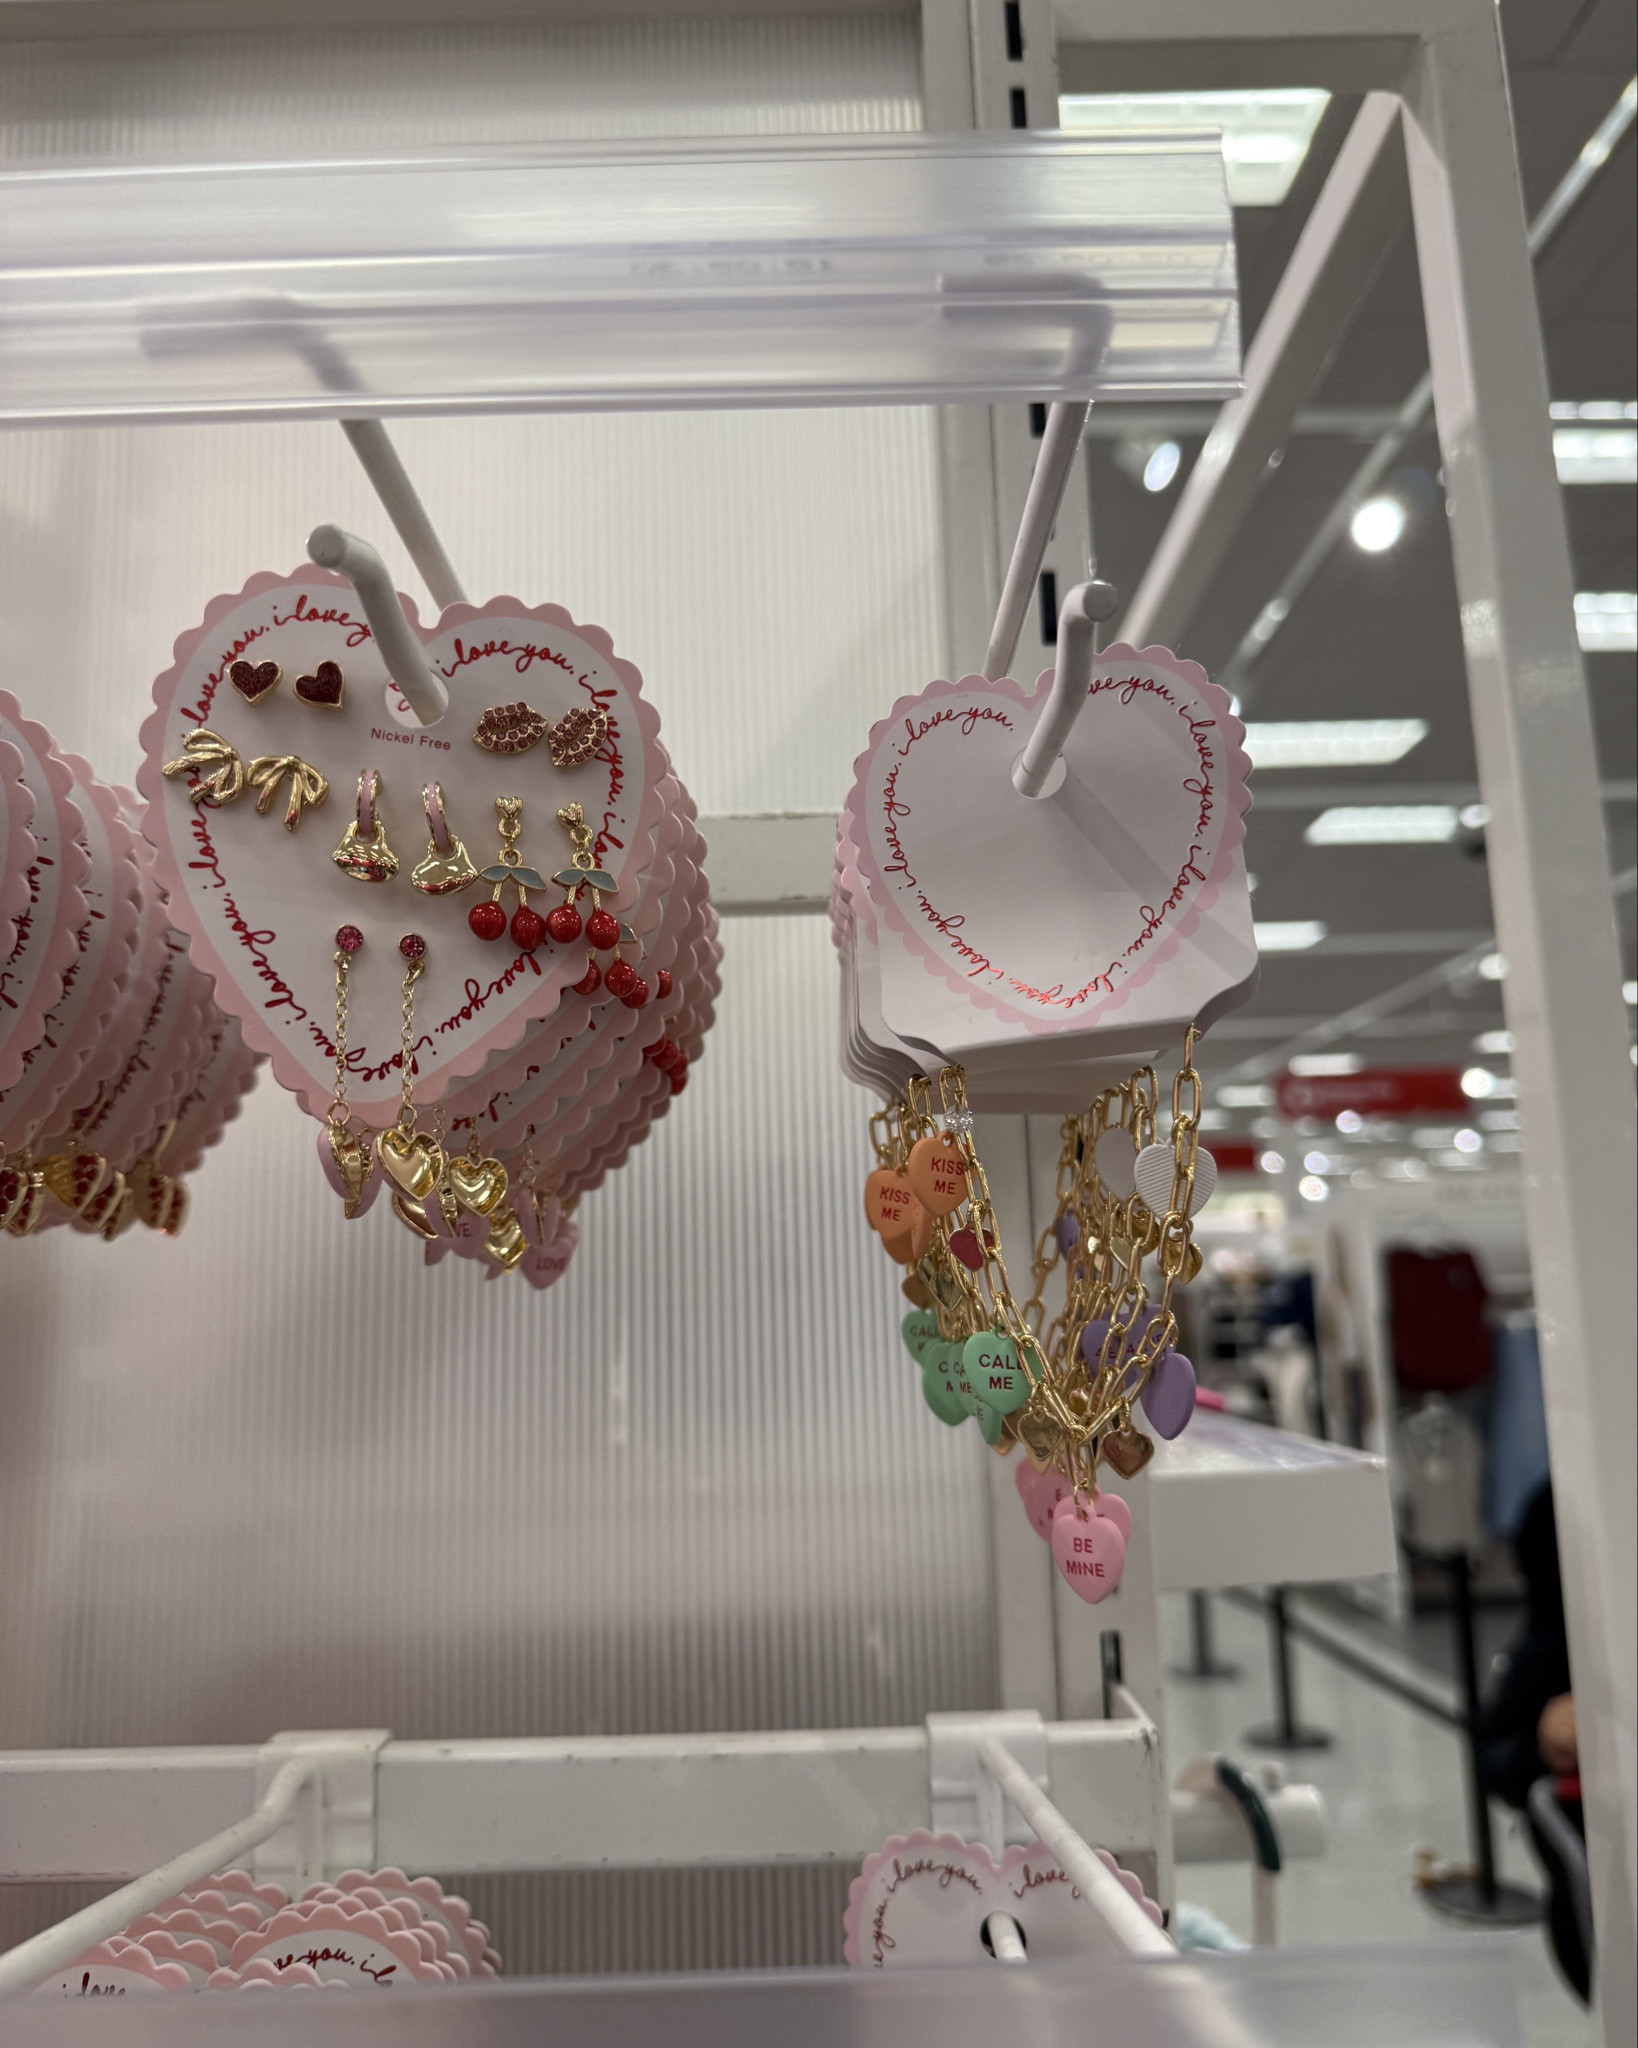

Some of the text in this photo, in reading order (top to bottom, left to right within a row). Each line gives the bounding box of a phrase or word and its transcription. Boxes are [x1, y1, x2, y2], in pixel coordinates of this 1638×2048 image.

[371, 728, 452, 751] Nickel Free
[930, 1157, 964, 1176] KISS
[934, 1180, 956, 1195] ME
[880, 1187, 911, 1205] KISS
[881, 1207, 902, 1221] ME
[536, 1257, 567, 1271] LOVE
[979, 1354, 1024, 1371] CALL
[959, 1381, 972, 1394] ME
[989, 1377, 1014, 1390] ME
[1073, 1537, 1093, 1553] BE
[1066, 1560, 1105, 1578] MINE
